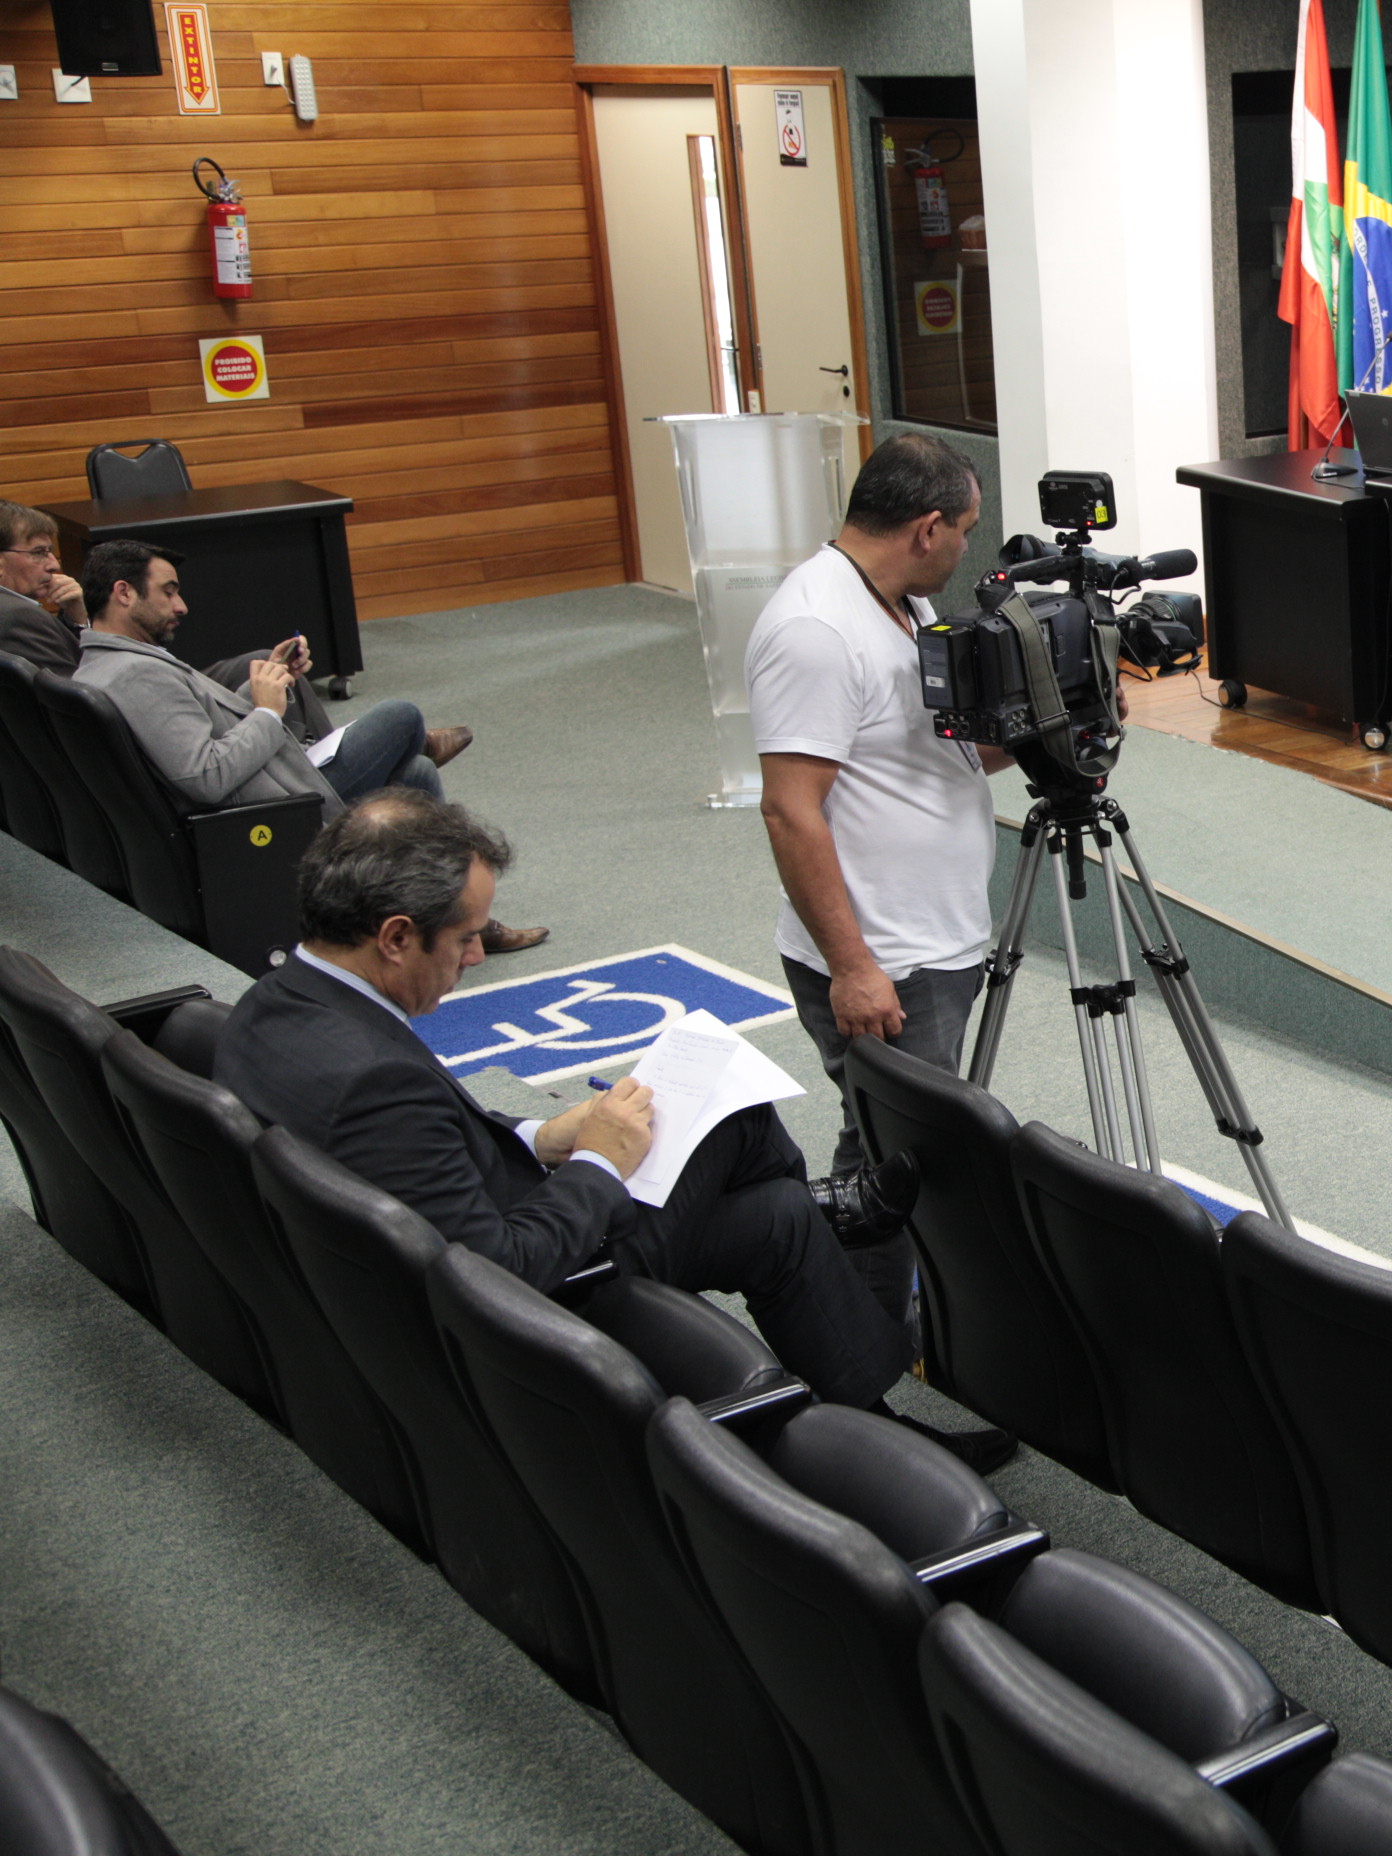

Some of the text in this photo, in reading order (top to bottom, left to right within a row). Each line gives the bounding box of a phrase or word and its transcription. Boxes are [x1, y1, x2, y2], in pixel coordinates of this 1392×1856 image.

[183, 17, 203, 94] EXTINTOR
[214, 356, 252, 366] PROIBIDO
[217, 364, 252, 374] COLOCAR
[215, 372, 256, 382] MATERIAIS
[257, 830, 268, 841] A
